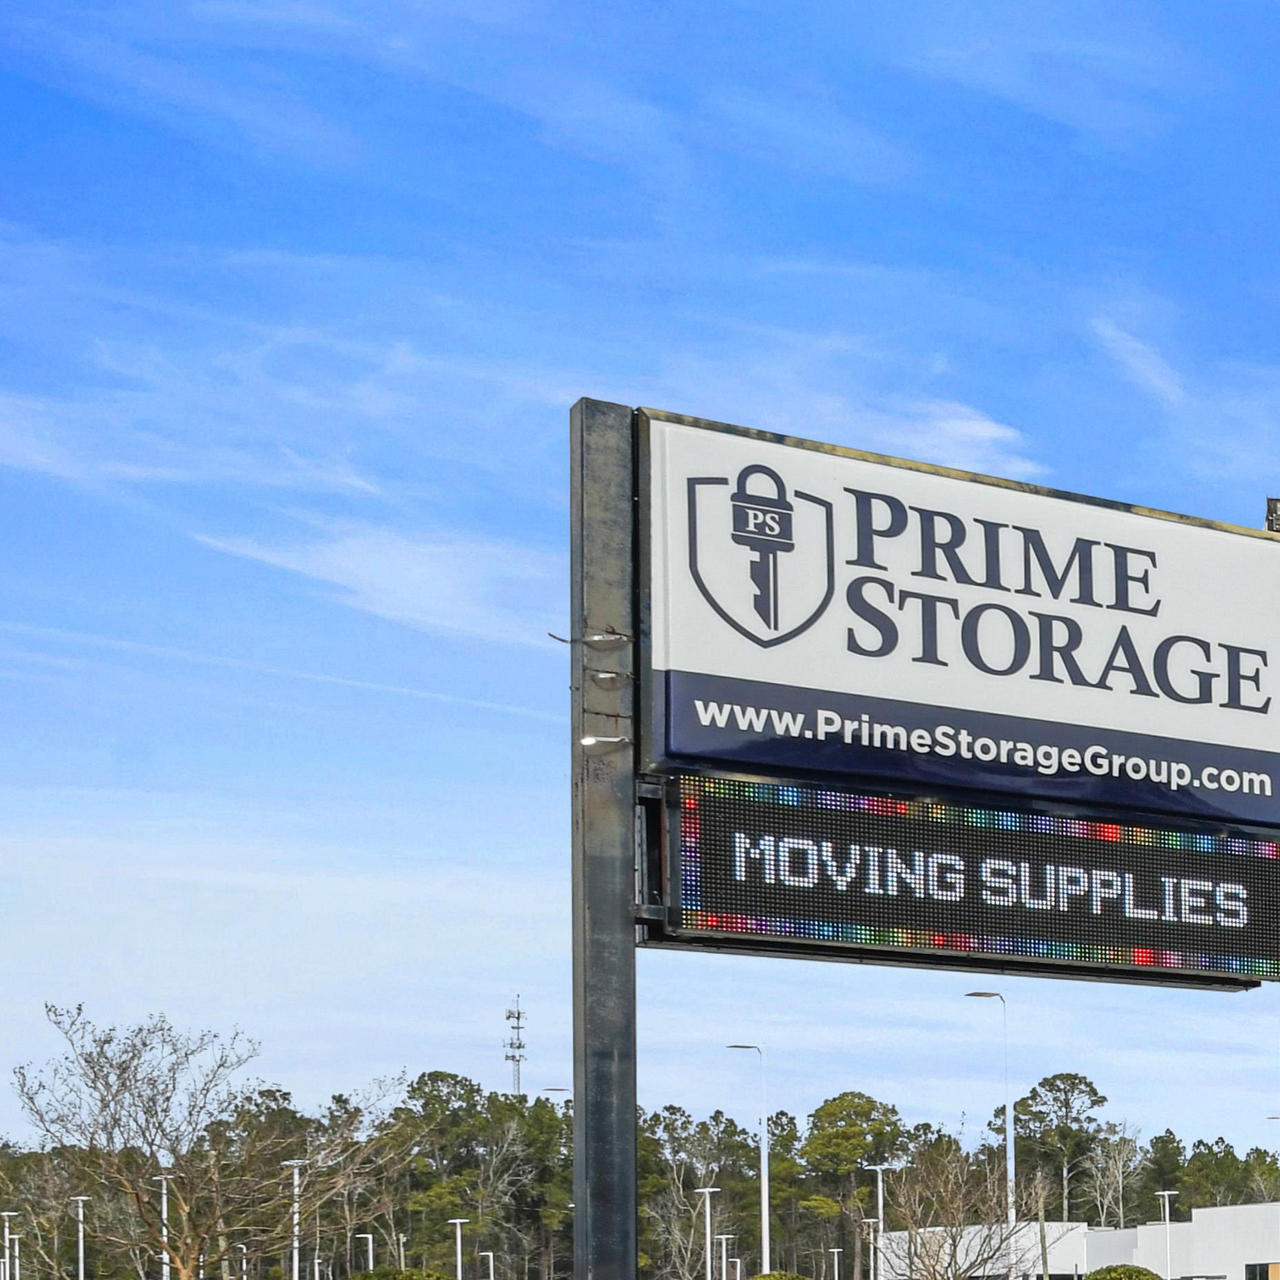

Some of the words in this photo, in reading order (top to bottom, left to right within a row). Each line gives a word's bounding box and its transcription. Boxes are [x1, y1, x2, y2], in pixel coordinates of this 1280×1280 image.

[745, 509, 780, 535] PS
[843, 487, 1161, 617] PRIME
[845, 575, 1272, 715] STORAGE
[694, 700, 1272, 796] www.PrimeStorageGroup.com
[733, 832, 964, 902] MOVING
[981, 857, 1248, 928] SUPPLIES
